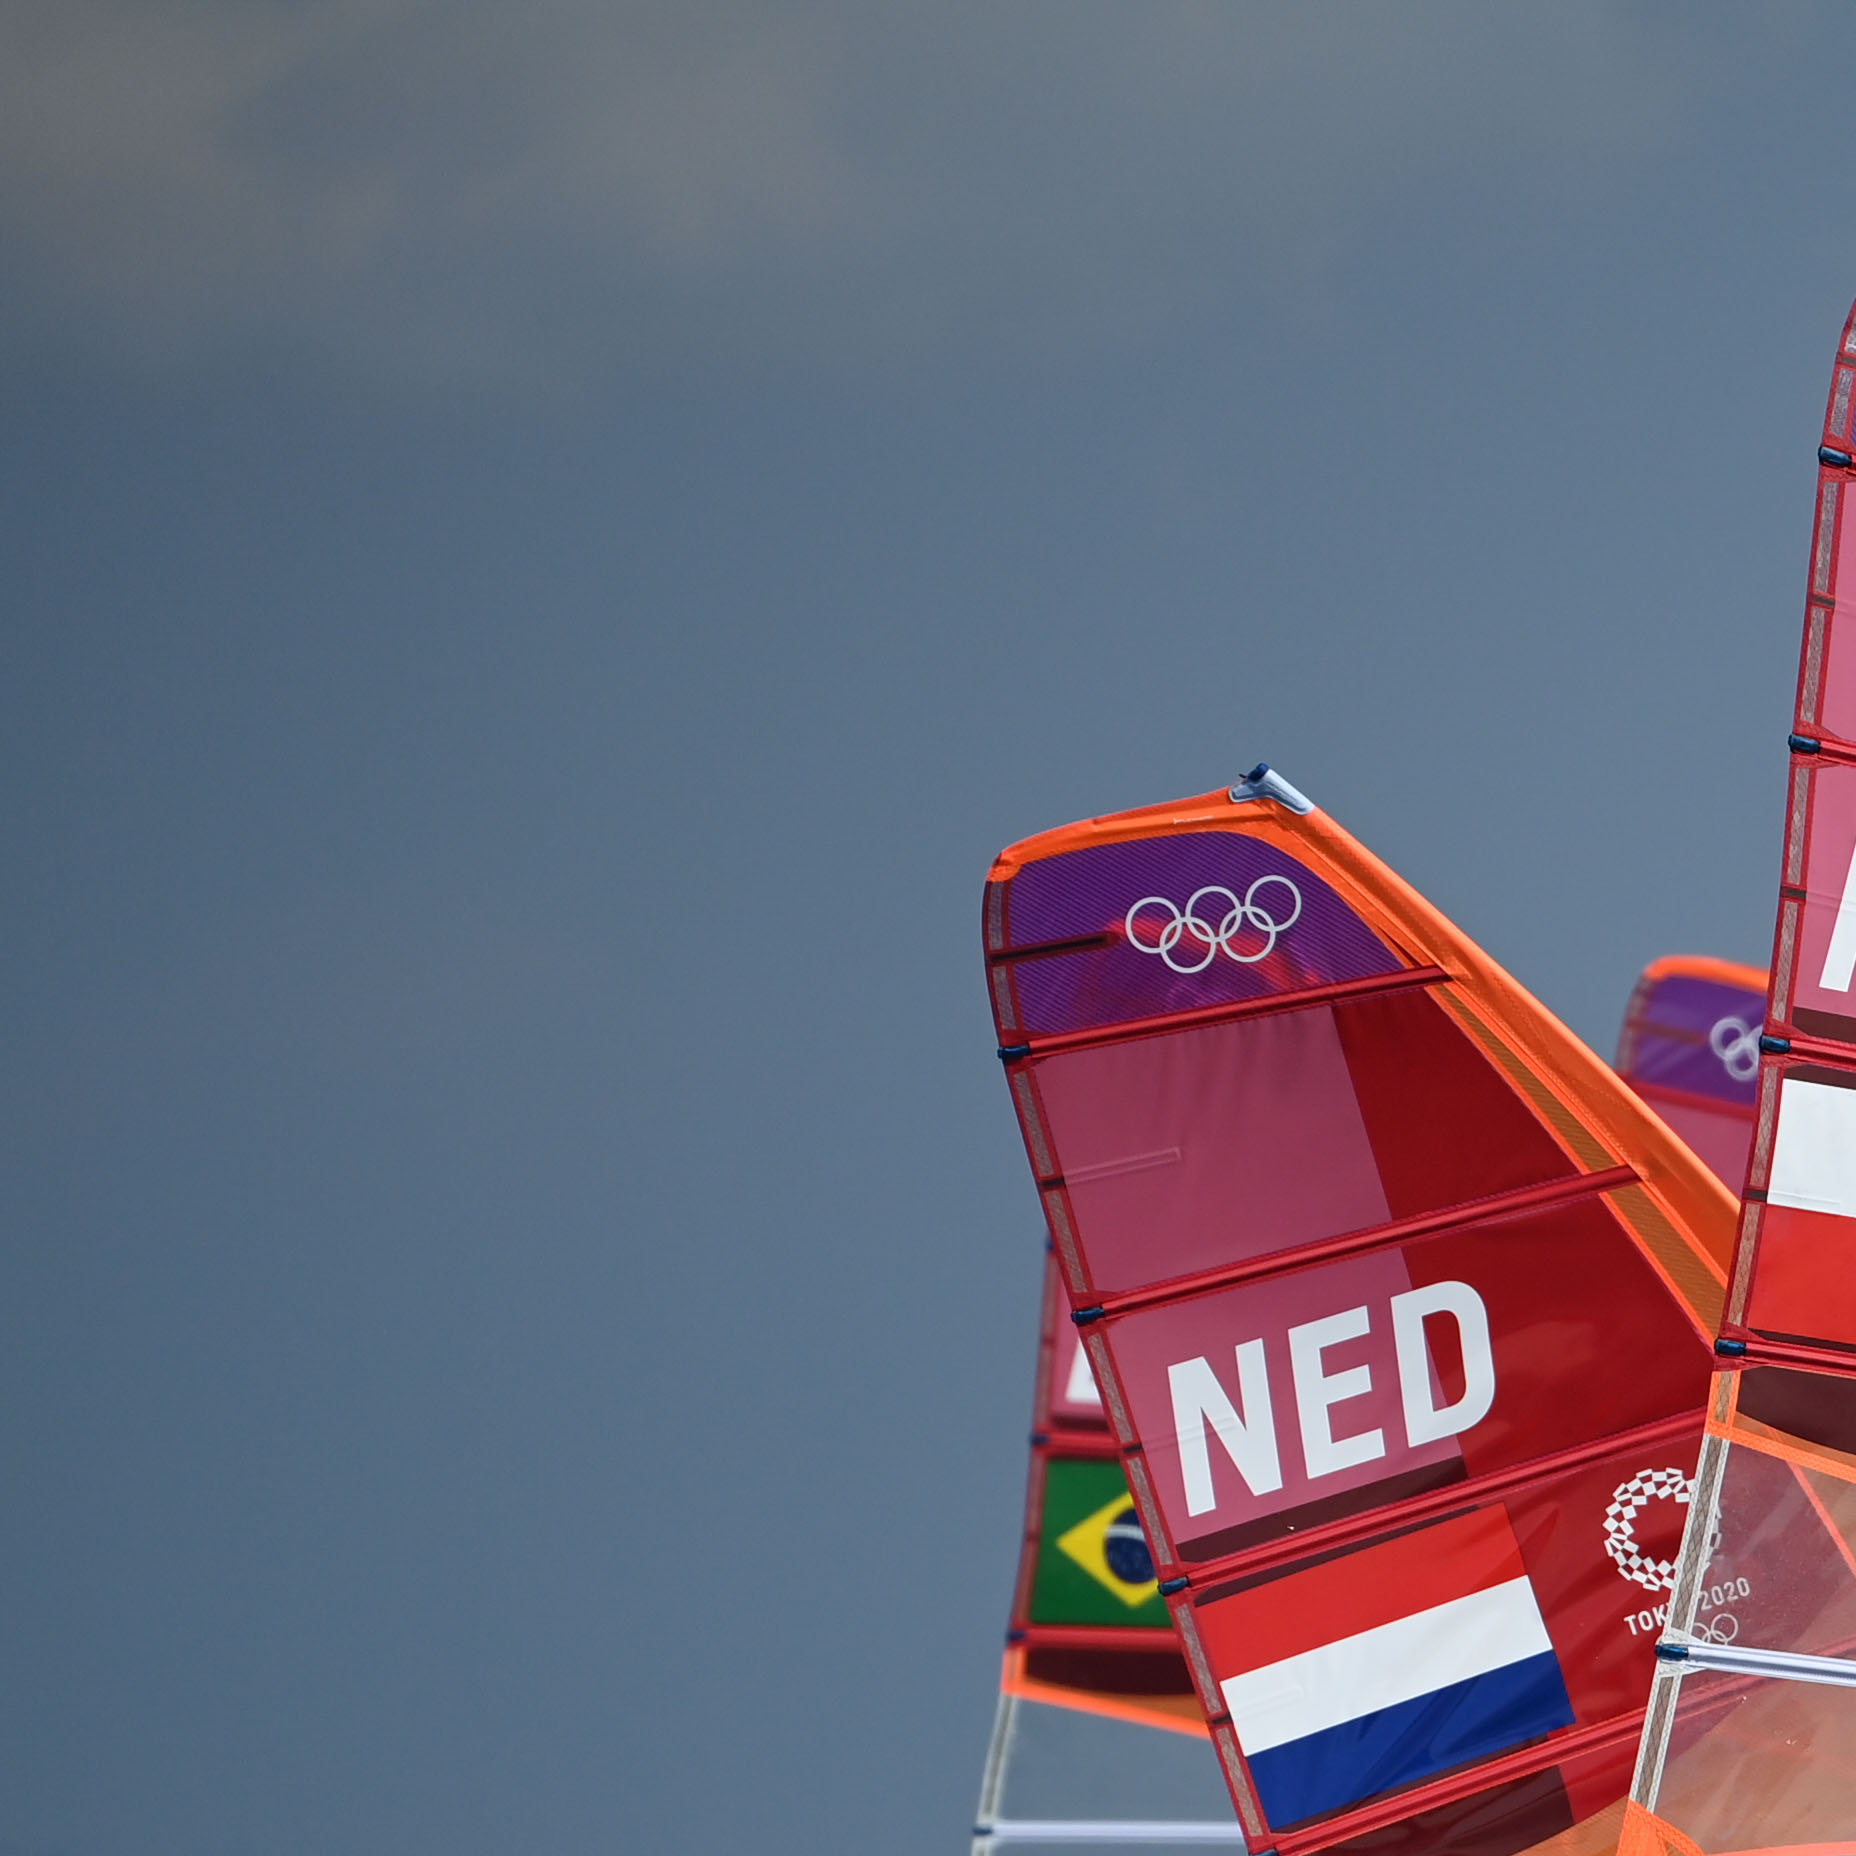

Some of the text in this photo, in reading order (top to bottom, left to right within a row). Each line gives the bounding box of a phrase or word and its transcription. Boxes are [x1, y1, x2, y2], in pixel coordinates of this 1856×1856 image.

[1167, 1280, 1496, 1517] NED
[1624, 1577, 1750, 1635] TOK 2020
